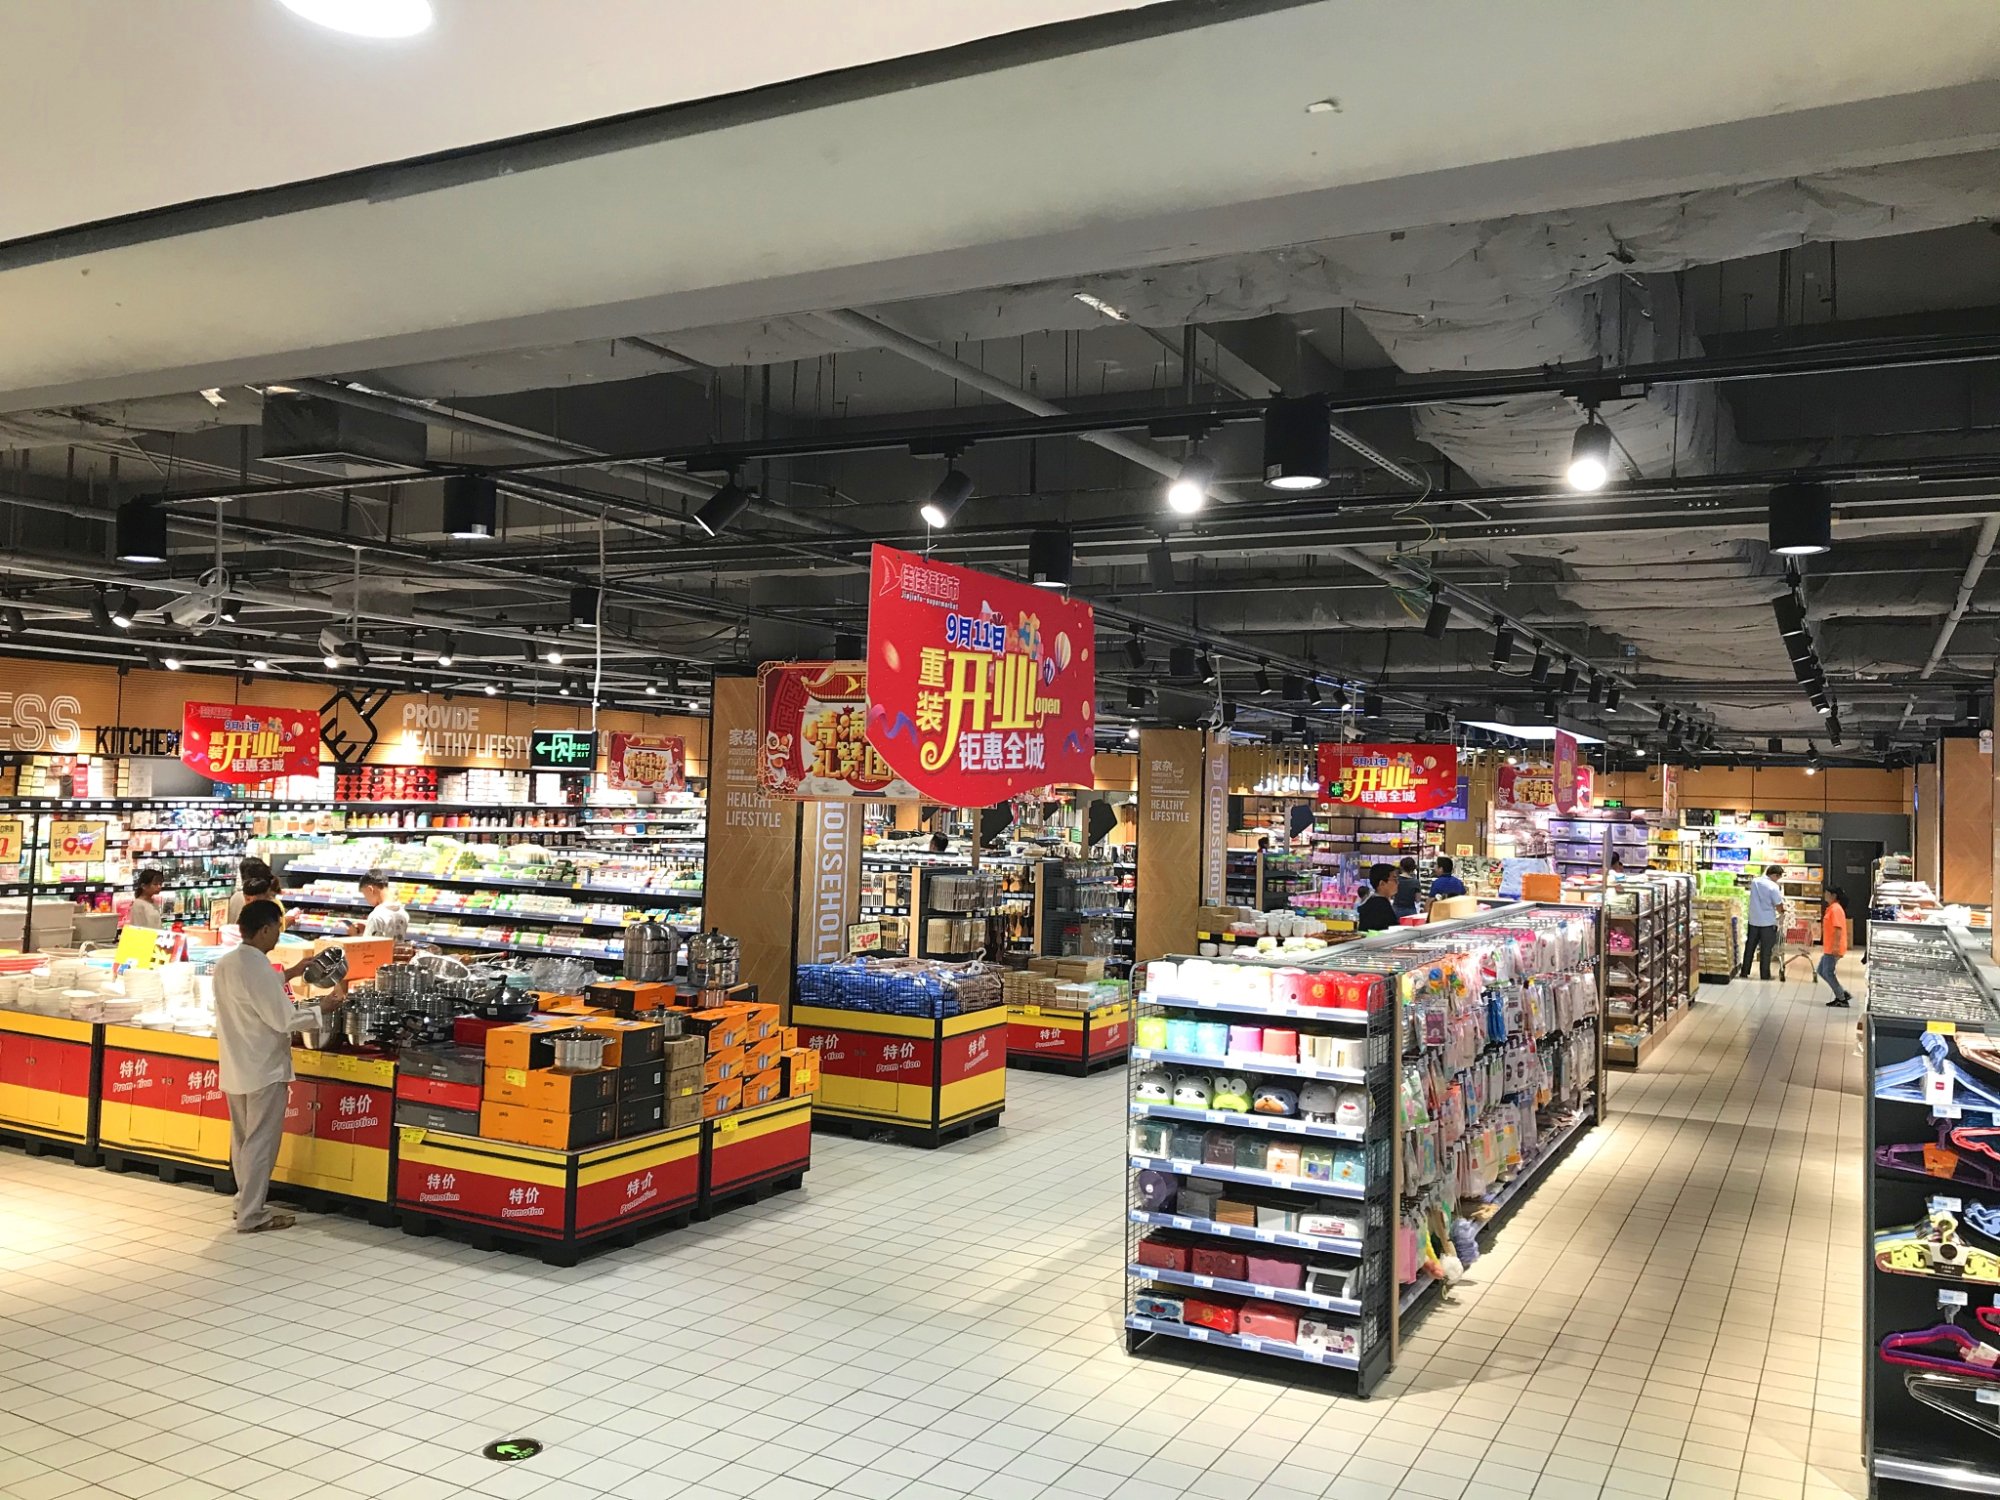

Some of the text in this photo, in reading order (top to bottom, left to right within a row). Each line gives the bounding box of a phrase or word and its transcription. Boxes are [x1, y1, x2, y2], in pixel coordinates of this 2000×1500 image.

[901, 563, 960, 600] 佳佳福超市
[946, 613, 1007, 653] 9月11日
[916, 647, 947, 732] 重装
[402, 702, 480, 731] PROVIDE
[920, 651, 1038, 771] 开业
[1035, 696, 1061, 729] open
[225, 720, 260, 733] 9月11日
[210, 732, 280, 772] 开业
[401, 729, 473, 757] HEALTHY
[958, 731, 1045, 771] 钜惠全城
[231, 759, 285, 772] 钜惠全城
[1151, 799, 1185, 811] HEALTHY
[1361, 790, 1416, 803] 钜惠全城
[726, 810, 781, 828] LIFESTYLE
[1150, 811, 1190, 822] LIFESTYLE
[1210, 796, 1222, 904] HOUSEHOL
[809, 1033, 839, 1051] 特价
[1039, 1028, 1062, 1040] 特价
[883, 1042, 915, 1060] 特价
[968, 1034, 987, 1057] 特价
[119, 1058, 148, 1078] 特价
[188, 1069, 217, 1090] 特价
[340, 1094, 372, 1115] 特价
[331, 1117, 378, 1130] Promotion
[427, 1173, 456, 1189] 特价
[626, 1171, 653, 1198] 特价
[420, 1192, 460, 1202] Promotion
[509, 1187, 540, 1205] 特价
[620, 1188, 658, 1215] Promotion
[502, 1206, 544, 1218] Promotion
